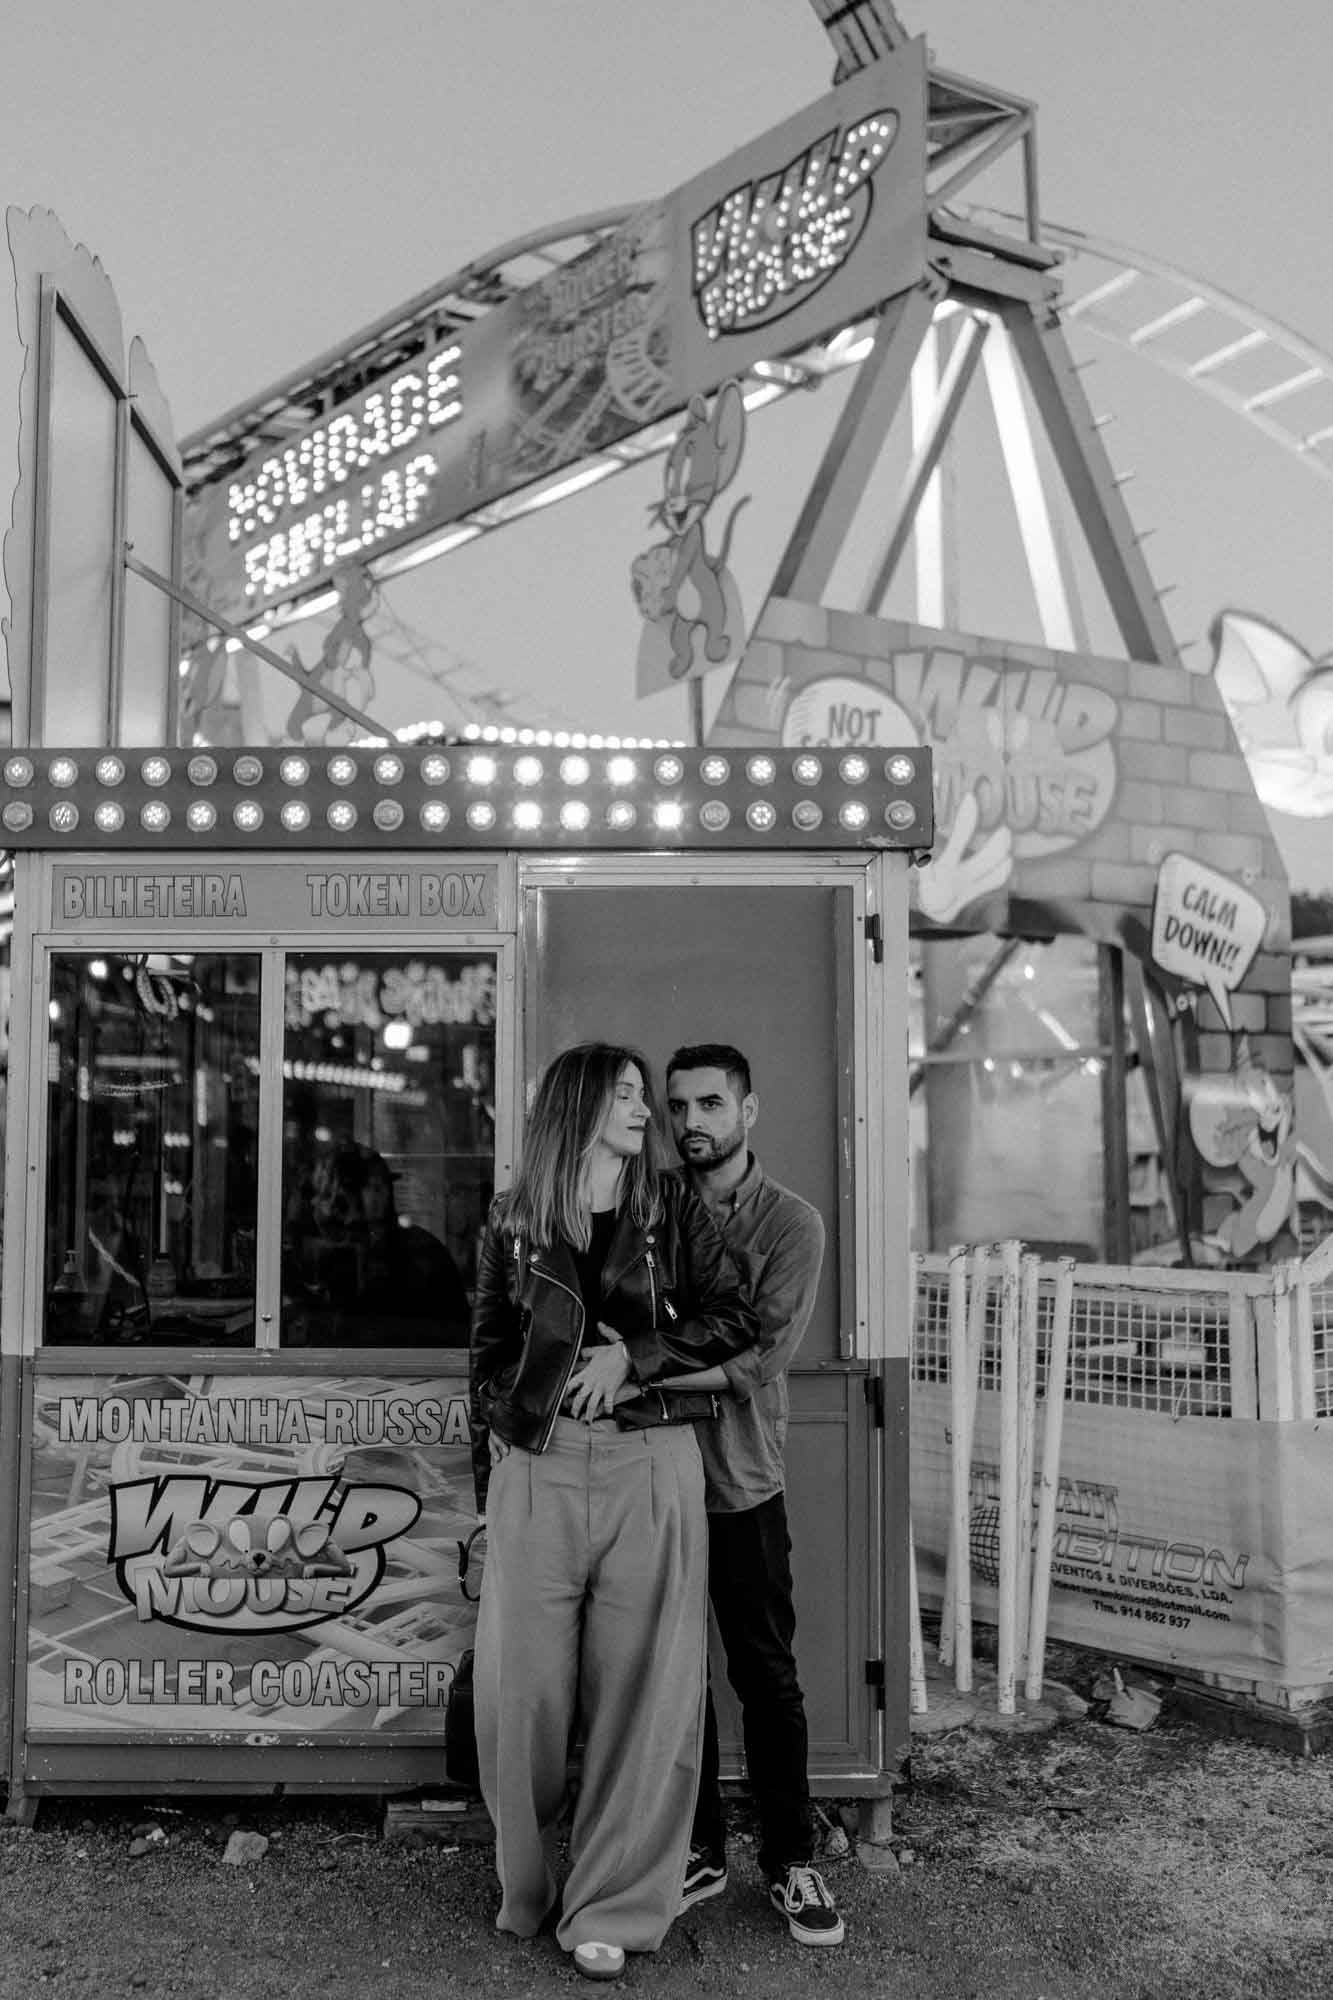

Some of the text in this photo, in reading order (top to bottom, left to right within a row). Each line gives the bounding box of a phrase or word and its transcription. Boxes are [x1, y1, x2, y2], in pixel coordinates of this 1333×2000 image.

[690, 107, 900, 296] WILD
[829, 703, 882, 743] NOT
[64, 875, 247, 919] BILHETEIRA
[306, 873, 486, 917] TOKEN BOX
[1183, 882, 1239, 932] CALM
[1164, 914, 1241, 972] DOWN!!
[58, 1397, 472, 1445] MONTANHA RUSSA
[107, 1475, 423, 1563] WILD
[133, 1566, 360, 1623] MOUSE
[1107, 1573, 1116, 1584] &
[1120, 1605, 1142, 1619] 914
[1145, 1611, 1167, 1625] 862
[1168, 1615, 1191, 1629] 937
[64, 1658, 455, 1708] ROLLER COASTER
